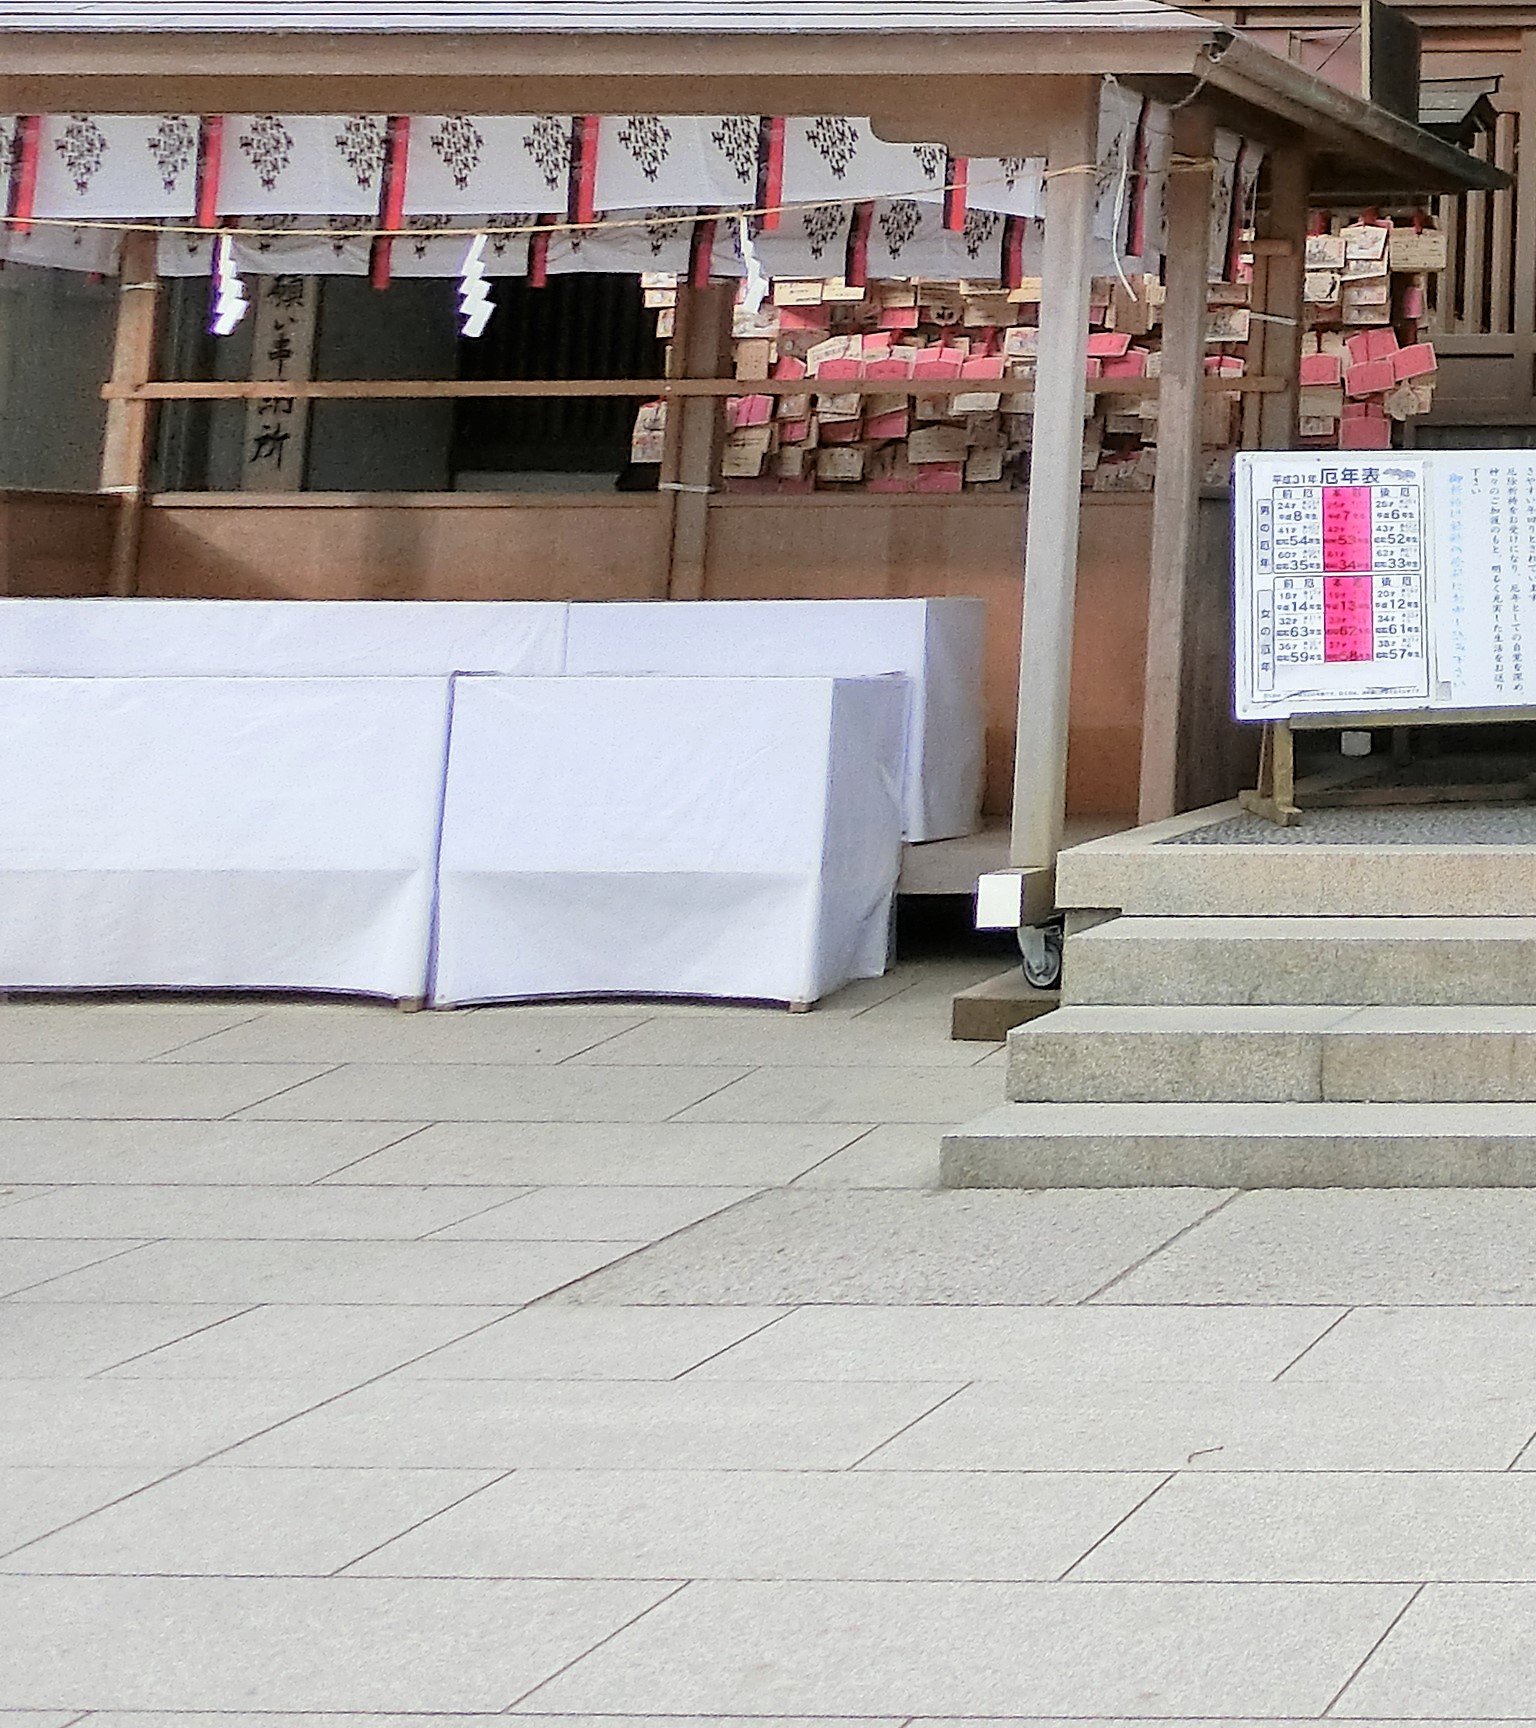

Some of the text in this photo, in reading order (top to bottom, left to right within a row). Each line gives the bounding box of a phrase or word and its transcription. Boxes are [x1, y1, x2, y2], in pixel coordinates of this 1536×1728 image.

[1272, 467, 1381, 485] 平成31年 厄年表
[1470, 467, 1481, 495] 下さい
